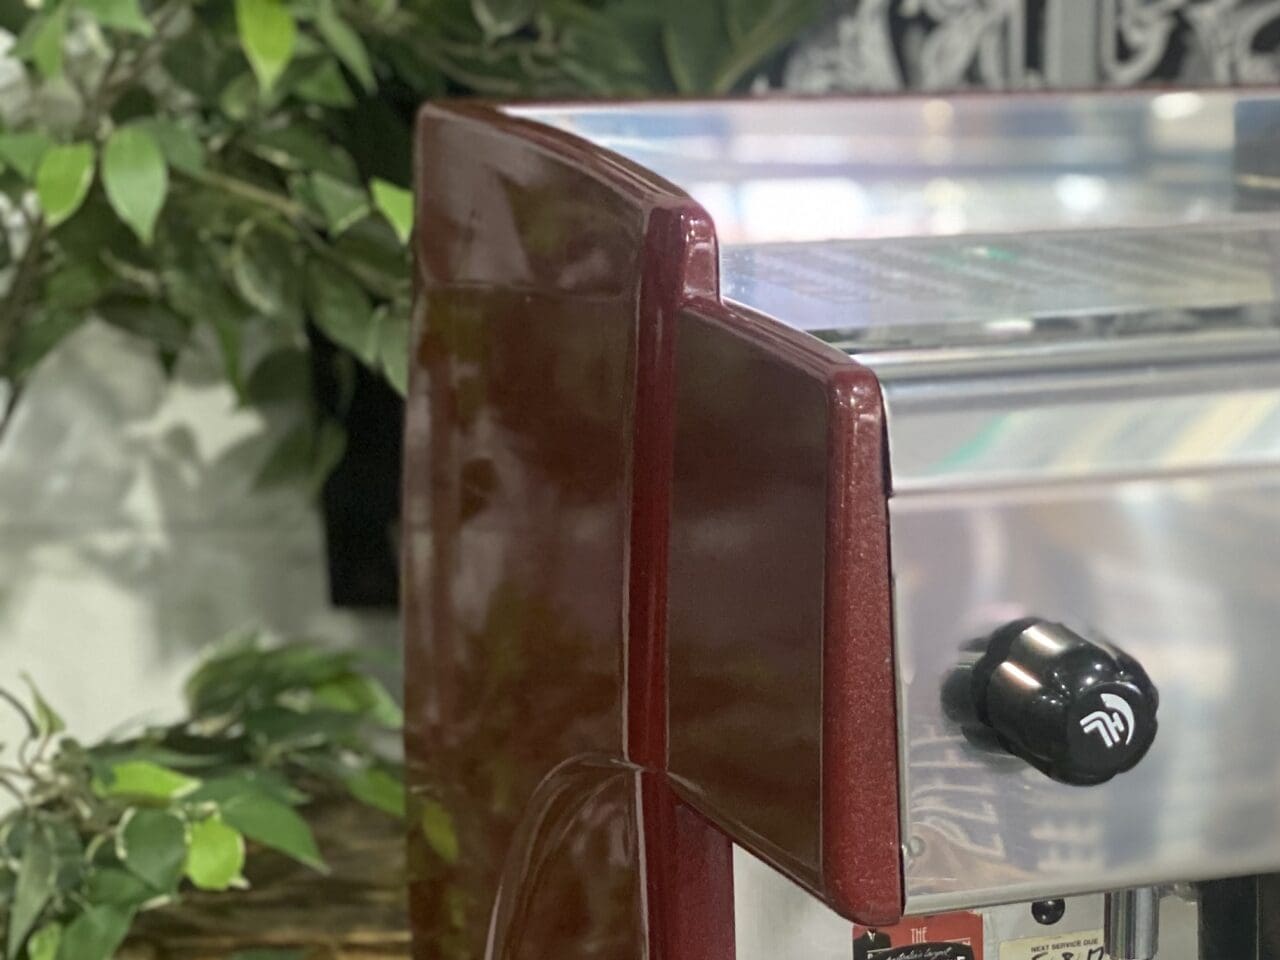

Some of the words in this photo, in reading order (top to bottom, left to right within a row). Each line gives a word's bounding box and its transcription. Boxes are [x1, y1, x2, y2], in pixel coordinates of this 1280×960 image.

[911, 926, 928, 944] THE
[1030, 944, 1049, 953] NEXT
[1051, 940, 1082, 951] SERVICE
[1083, 938, 1099, 946] DUE
